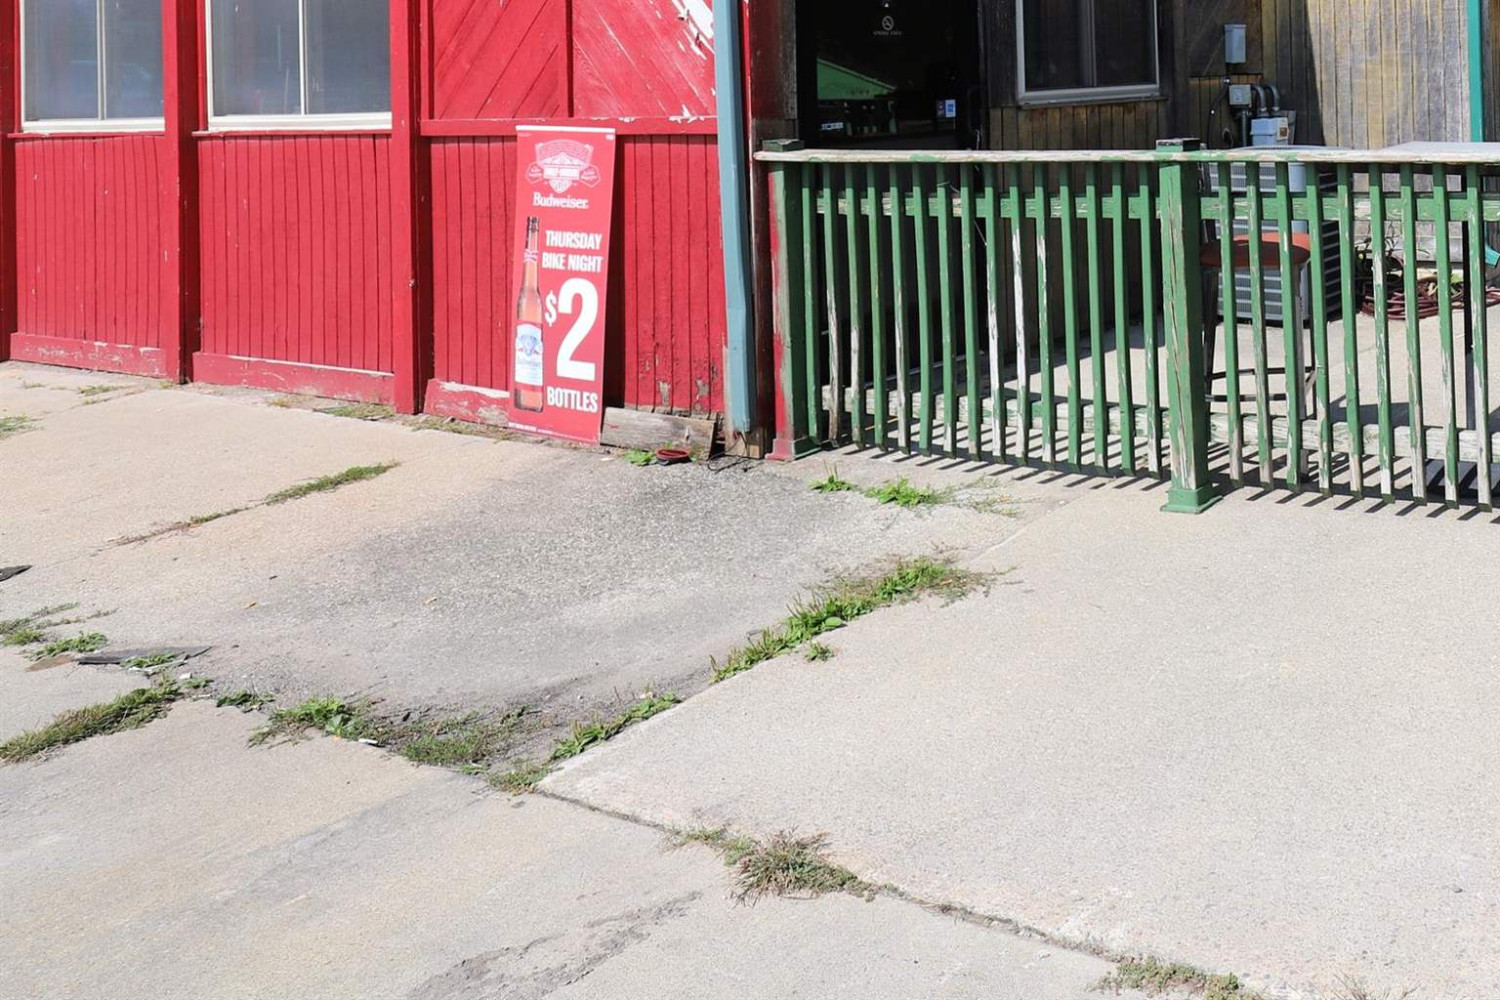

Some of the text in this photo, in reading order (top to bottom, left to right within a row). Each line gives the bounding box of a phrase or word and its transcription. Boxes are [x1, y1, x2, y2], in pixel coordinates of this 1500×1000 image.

[532, 191, 589, 209] Budweiser
[545, 230, 602, 250] THURSDAY
[542, 252, 603, 272] BIKE NIGHT
[545, 278, 598, 381] $2
[547, 386, 598, 413] BOTTLES
